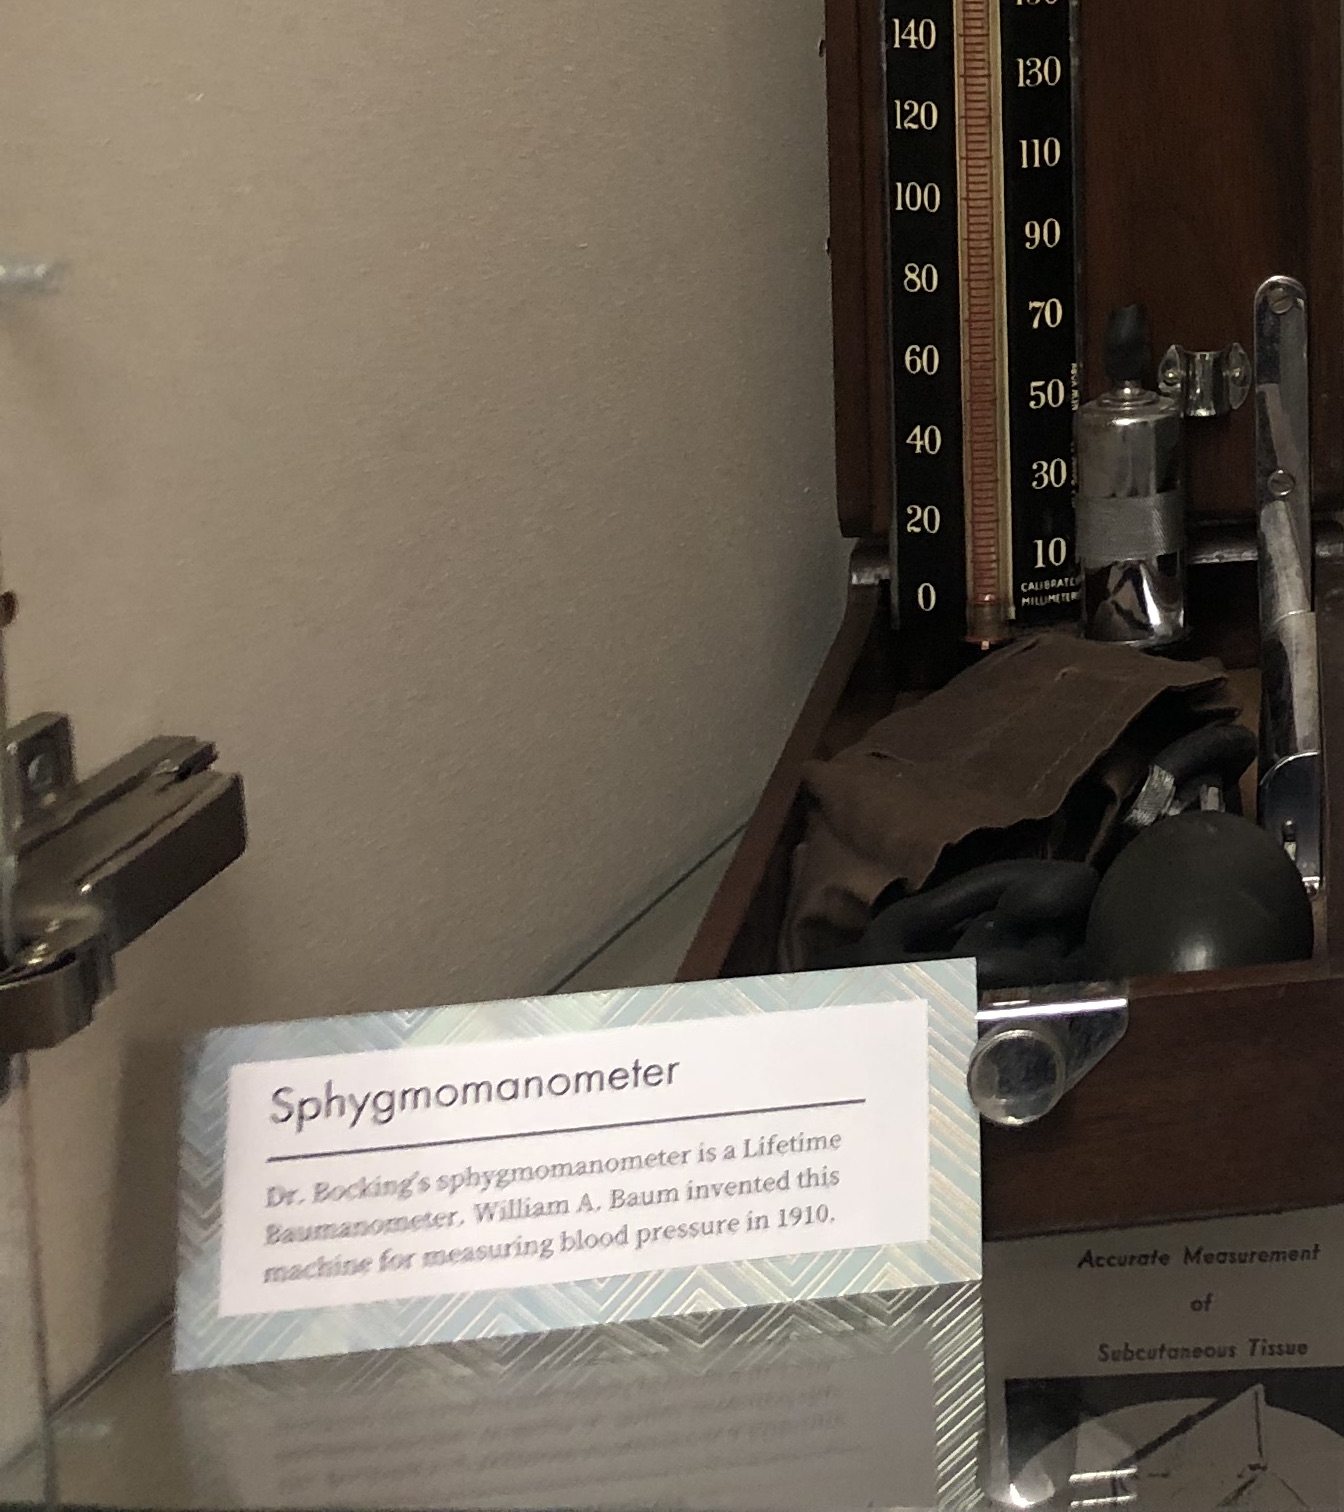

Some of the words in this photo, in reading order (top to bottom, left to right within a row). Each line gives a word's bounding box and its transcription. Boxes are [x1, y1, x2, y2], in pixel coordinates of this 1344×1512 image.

[894, 19, 936, 49] 140
[1018, 56, 1061, 86] 130
[895, 100, 937, 130] 120
[1021, 138, 1060, 168] 110
[896, 182, 940, 212] 100
[1025, 218, 1060, 249] 90
[904, 263, 938, 292] 80
[1029, 298, 1062, 328] 70
[905, 345, 939, 375] 60
[1030, 379, 1064, 409] 50
[906, 425, 941, 454] 40
[1032, 458, 1066, 489] 30
[907, 505, 940, 533] 20
[1035, 538, 1066, 568] 10
[918, 583, 935, 611] 0
[271, 1059, 680, 1133] Sphygmomanometer
[266, 1186, 305, 1208] Dr.
[312, 1171, 430, 1203] Bocking's
[436, 1149, 691, 1196] sphygmomanometer
[697, 1142, 716, 1163] is
[723, 1145, 736, 1160] a
[743, 1132, 841, 1159] Lifetime
[1077, 1249, 1170, 1268] Accurate
[1183, 1244, 1321, 1265] Measurement
[1190, 1293, 1213, 1312] of
[1098, 1342, 1236, 1362] Subcutaneous
[1249, 1338, 1308, 1356] Tissue
